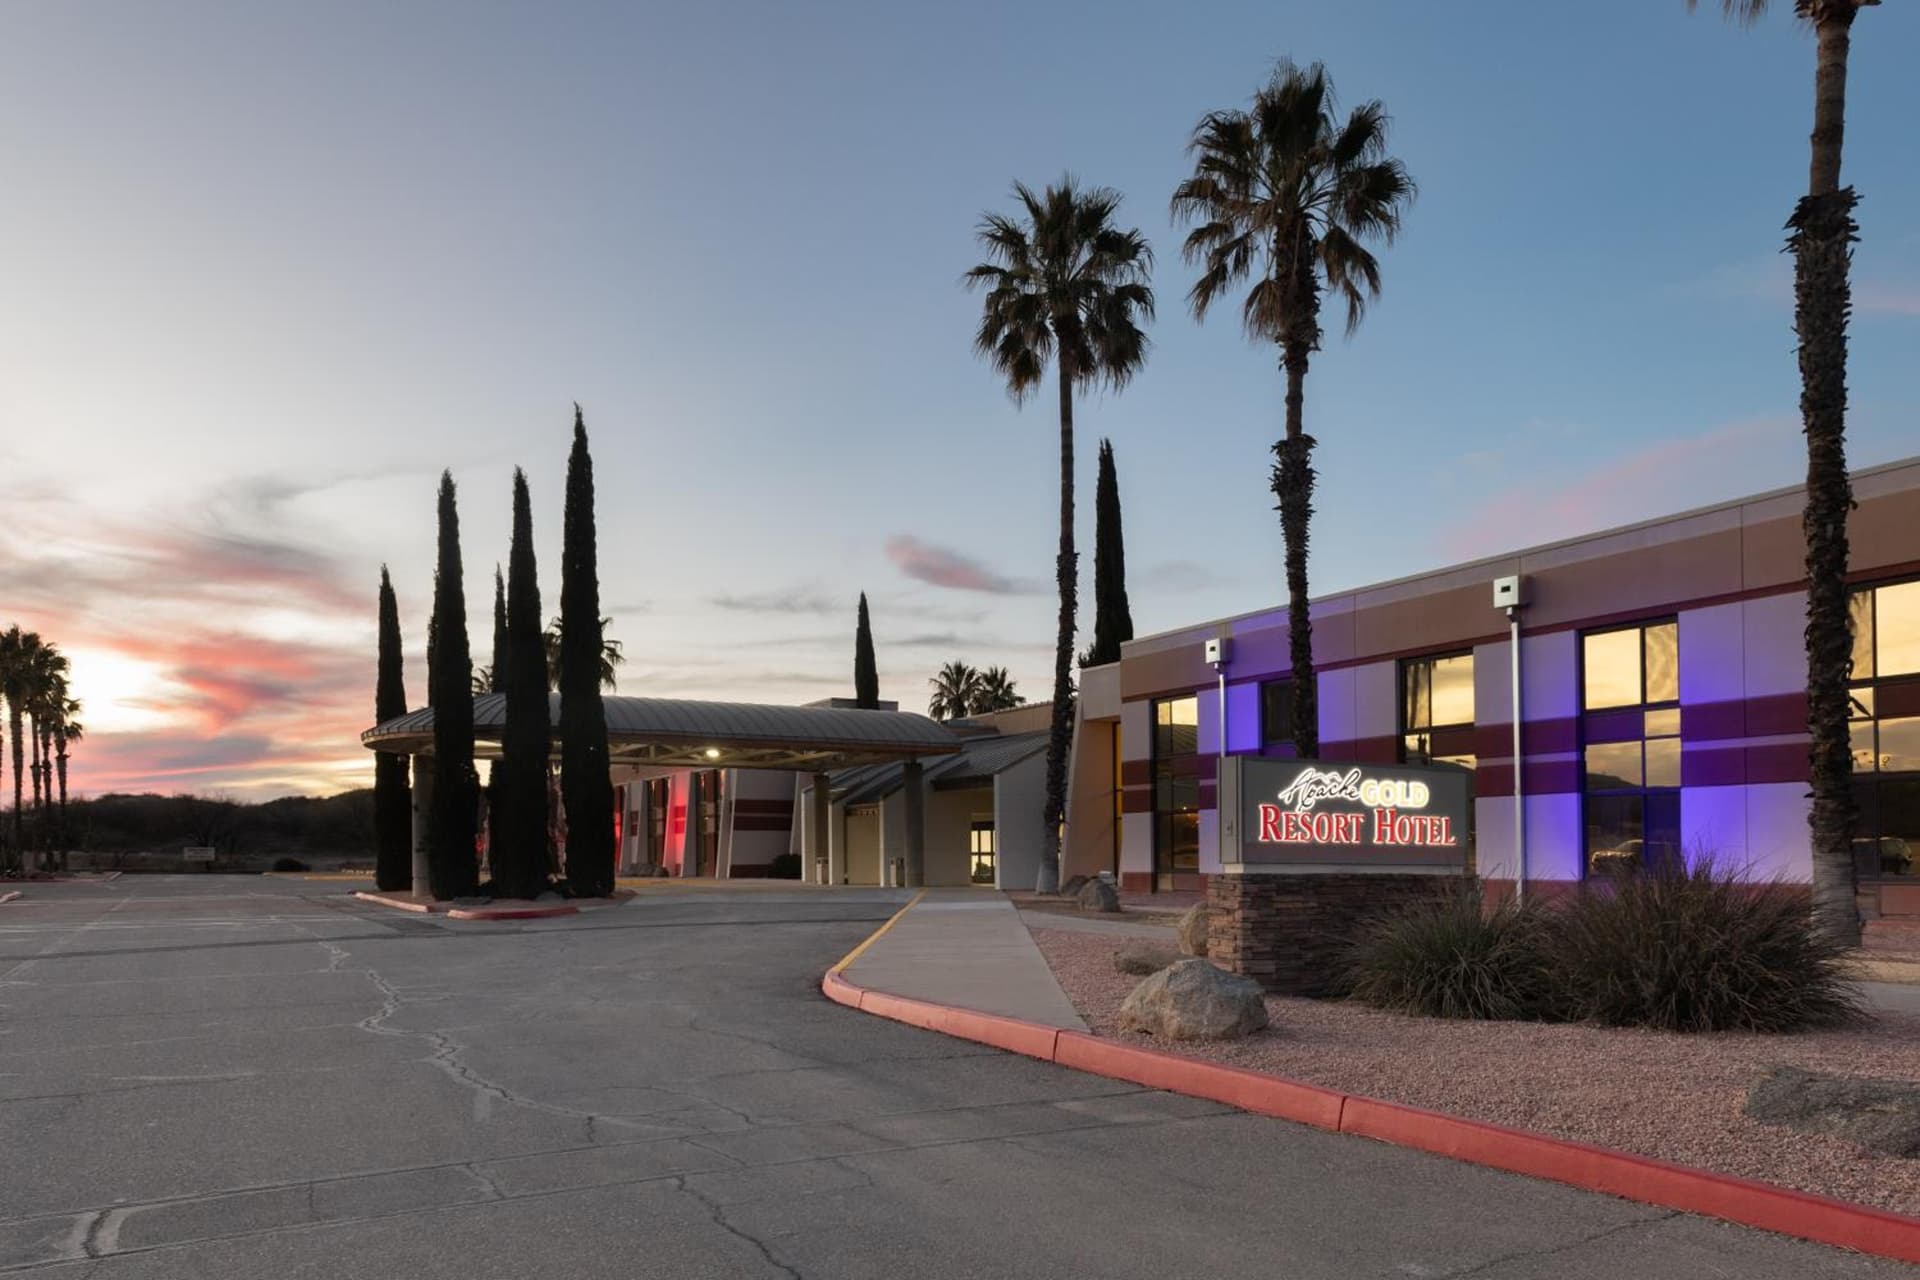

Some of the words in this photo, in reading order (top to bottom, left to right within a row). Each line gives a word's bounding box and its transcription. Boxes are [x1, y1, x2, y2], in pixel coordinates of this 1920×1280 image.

[1278, 767, 1361, 812] Apache
[1359, 778, 1430, 808] GOLD
[1258, 804, 1364, 844] RESORT
[1373, 807, 1456, 846] HOTEL
